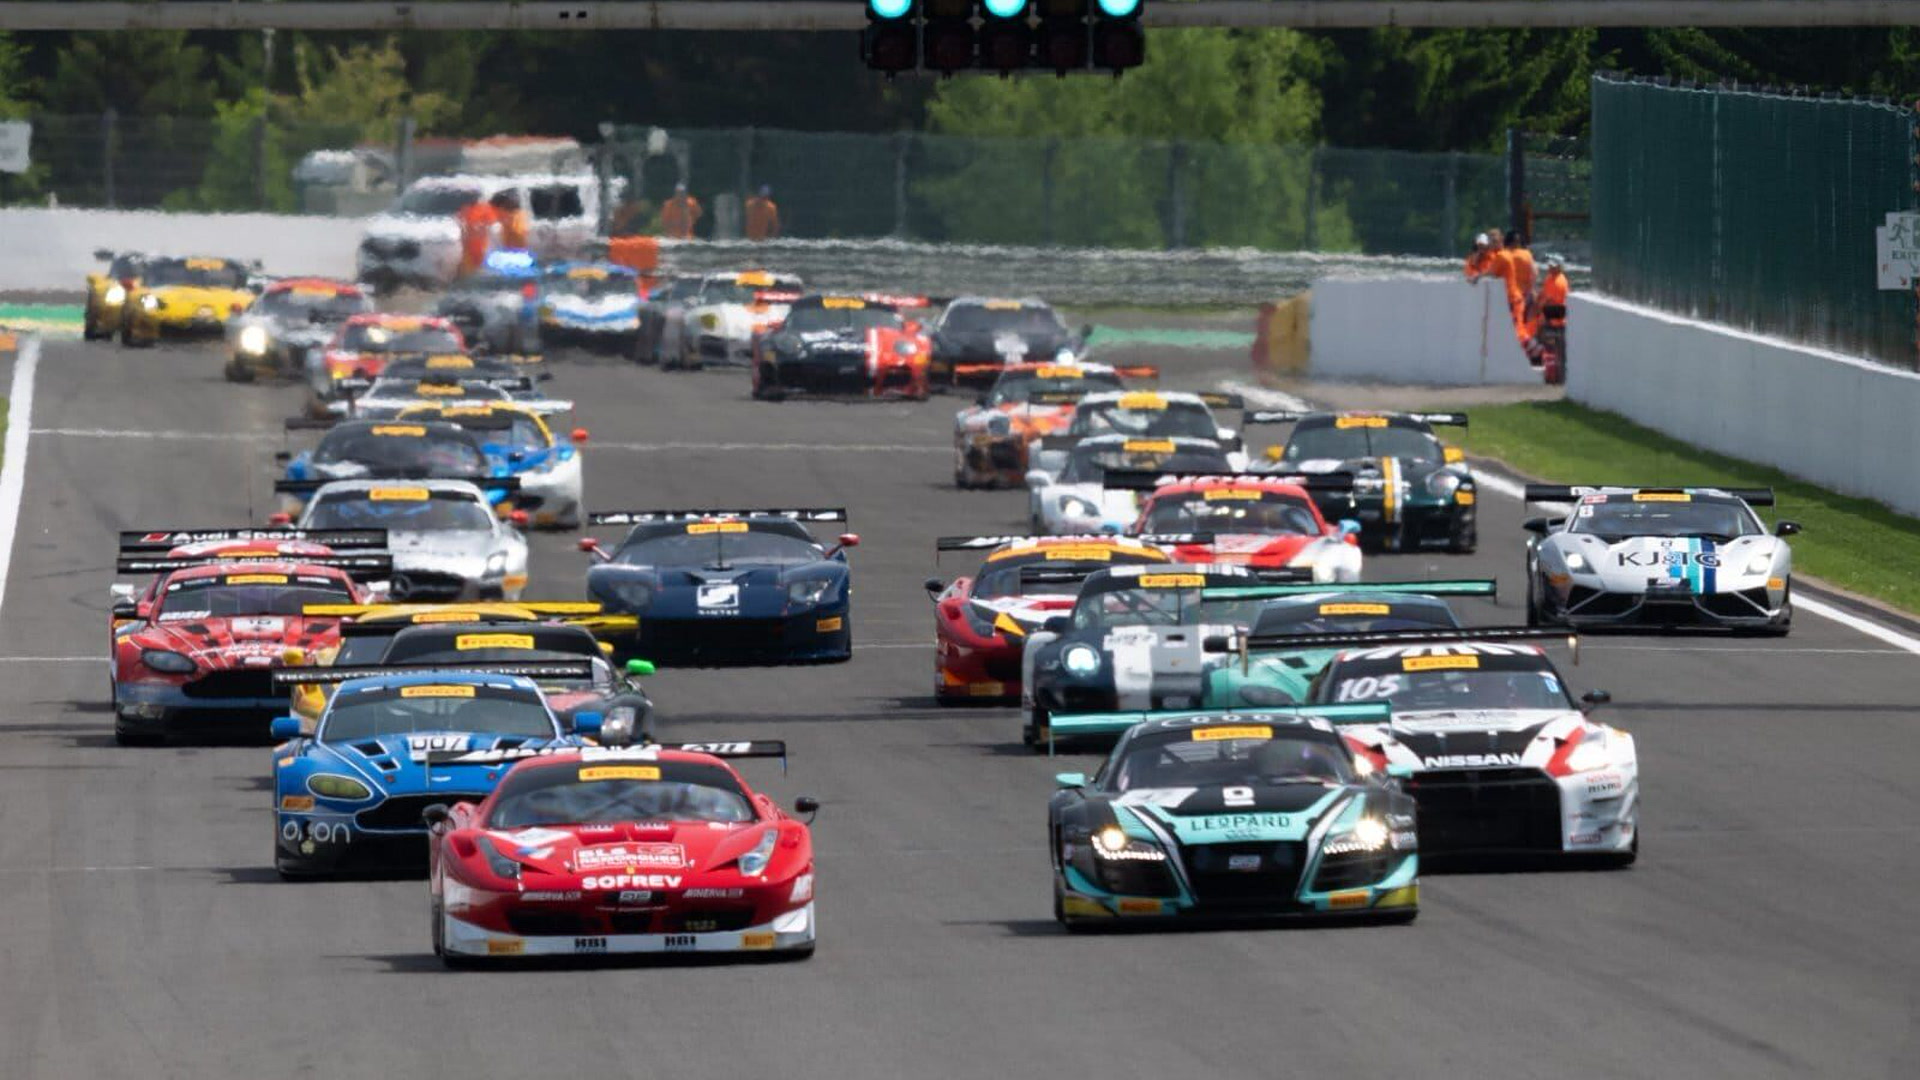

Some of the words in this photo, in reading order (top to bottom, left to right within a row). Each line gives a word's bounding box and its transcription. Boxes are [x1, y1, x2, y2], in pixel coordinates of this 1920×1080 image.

[172, 532, 230, 545] Audi
[237, 529, 307, 541] Sport
[1339, 676, 1400, 701] 105
[1424, 754, 1521, 767] NISSAN
[1191, 815, 1290, 832] LEOPARD
[582, 875, 682, 889] SOFREV
